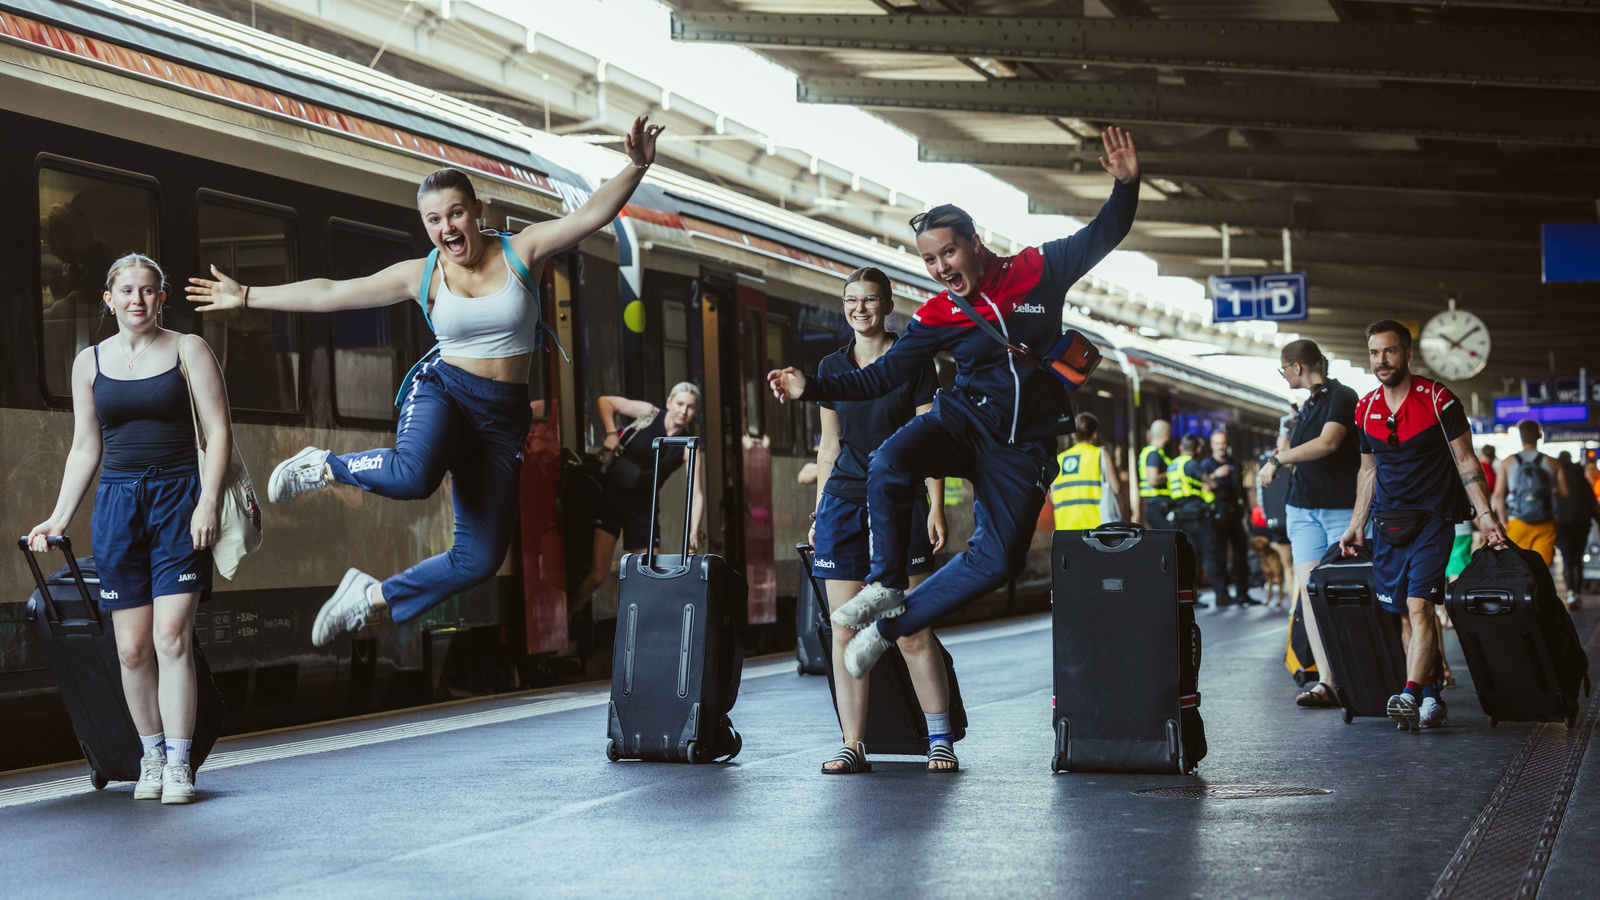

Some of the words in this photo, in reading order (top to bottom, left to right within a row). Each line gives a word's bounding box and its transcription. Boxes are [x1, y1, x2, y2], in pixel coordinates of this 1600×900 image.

[691, 279, 699, 308] 2
[1226, 289, 1241, 316] 1
[1271, 288, 1295, 314] D
[1012, 302, 1045, 314] bellach
[814, 557, 836, 569] bellach
[911, 556, 926, 566] JAKO
[178, 572, 197, 582] JAKO
